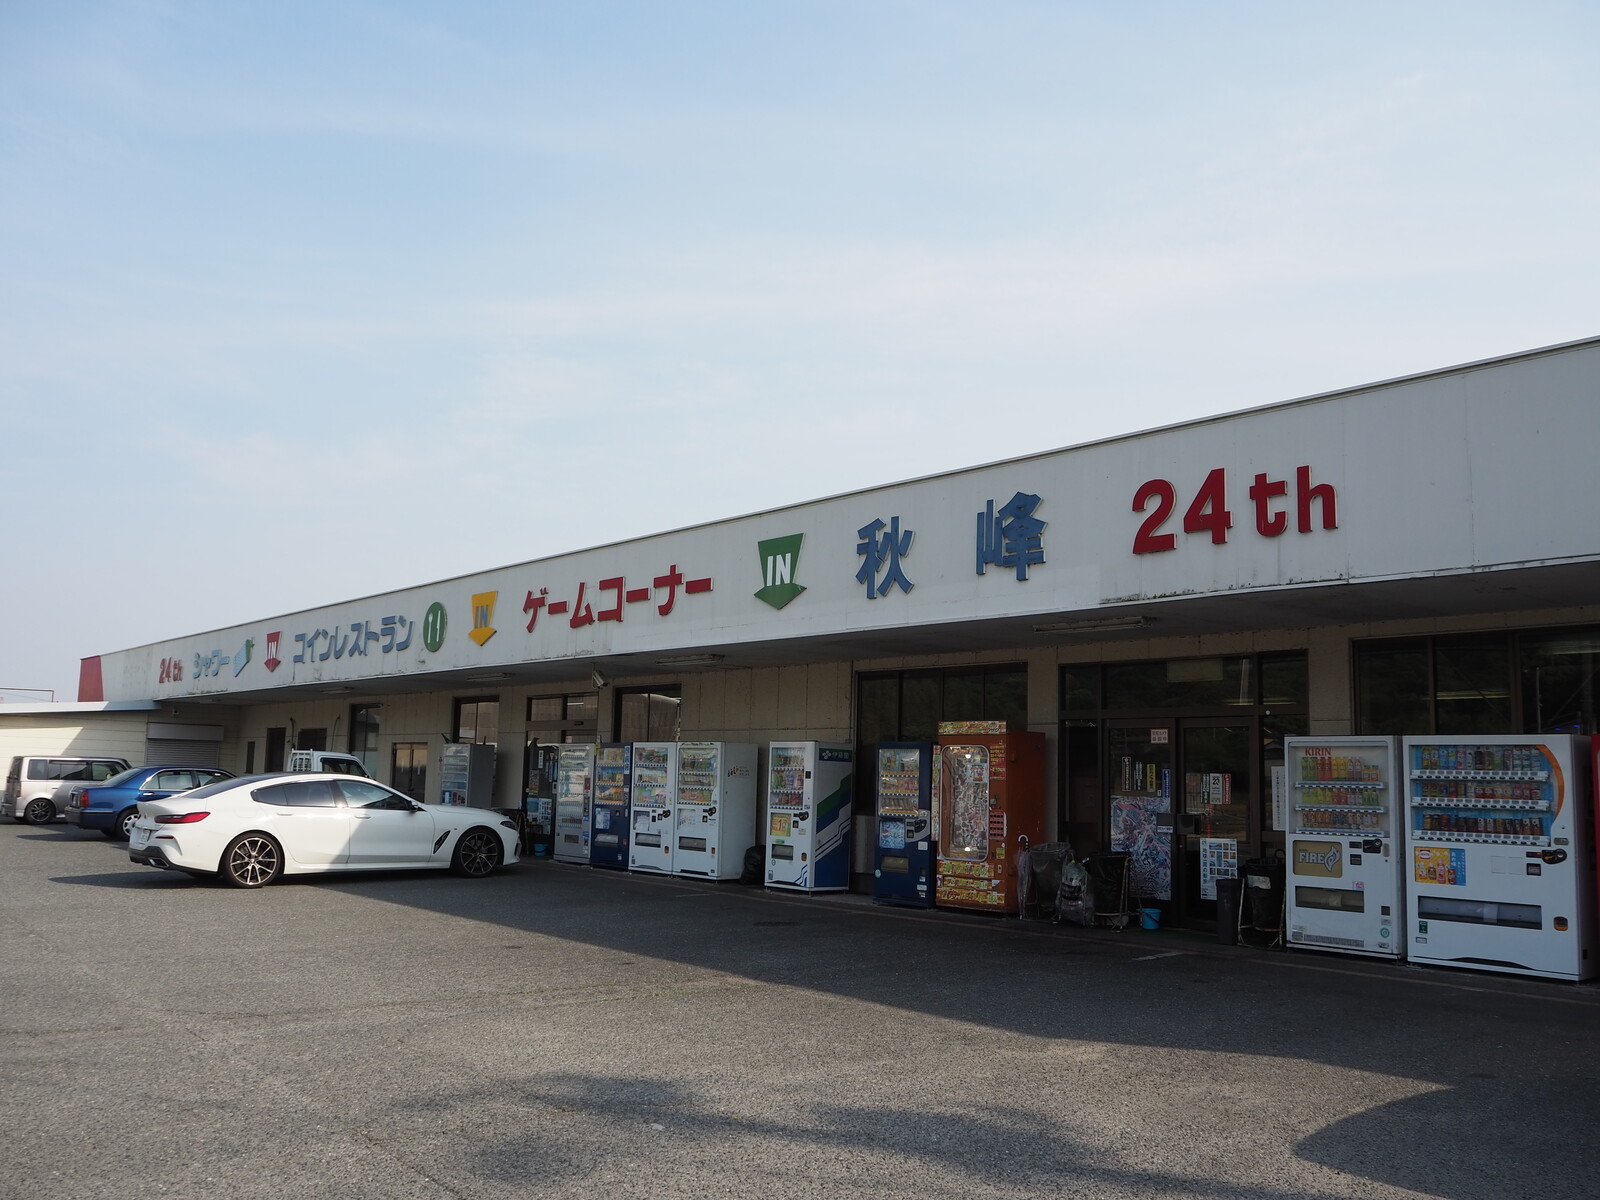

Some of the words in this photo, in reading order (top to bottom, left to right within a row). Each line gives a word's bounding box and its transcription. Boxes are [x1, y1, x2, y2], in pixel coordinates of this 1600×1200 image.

[1133, 466, 1337, 555] 24th
[855, 491, 1047, 600] 秋峰
[766, 553, 792, 587] IN
[523, 564, 712, 632] ゲームコーナー
[474, 605, 490, 629] IN
[268, 641, 278, 659] IN
[292, 615, 414, 664] コインレストラン
[158, 656, 184, 684] 24th
[192, 649, 231, 680] シャワー
[1304, 747, 1332, 757] KIRIN
[1298, 851, 1327, 866] FIRE
